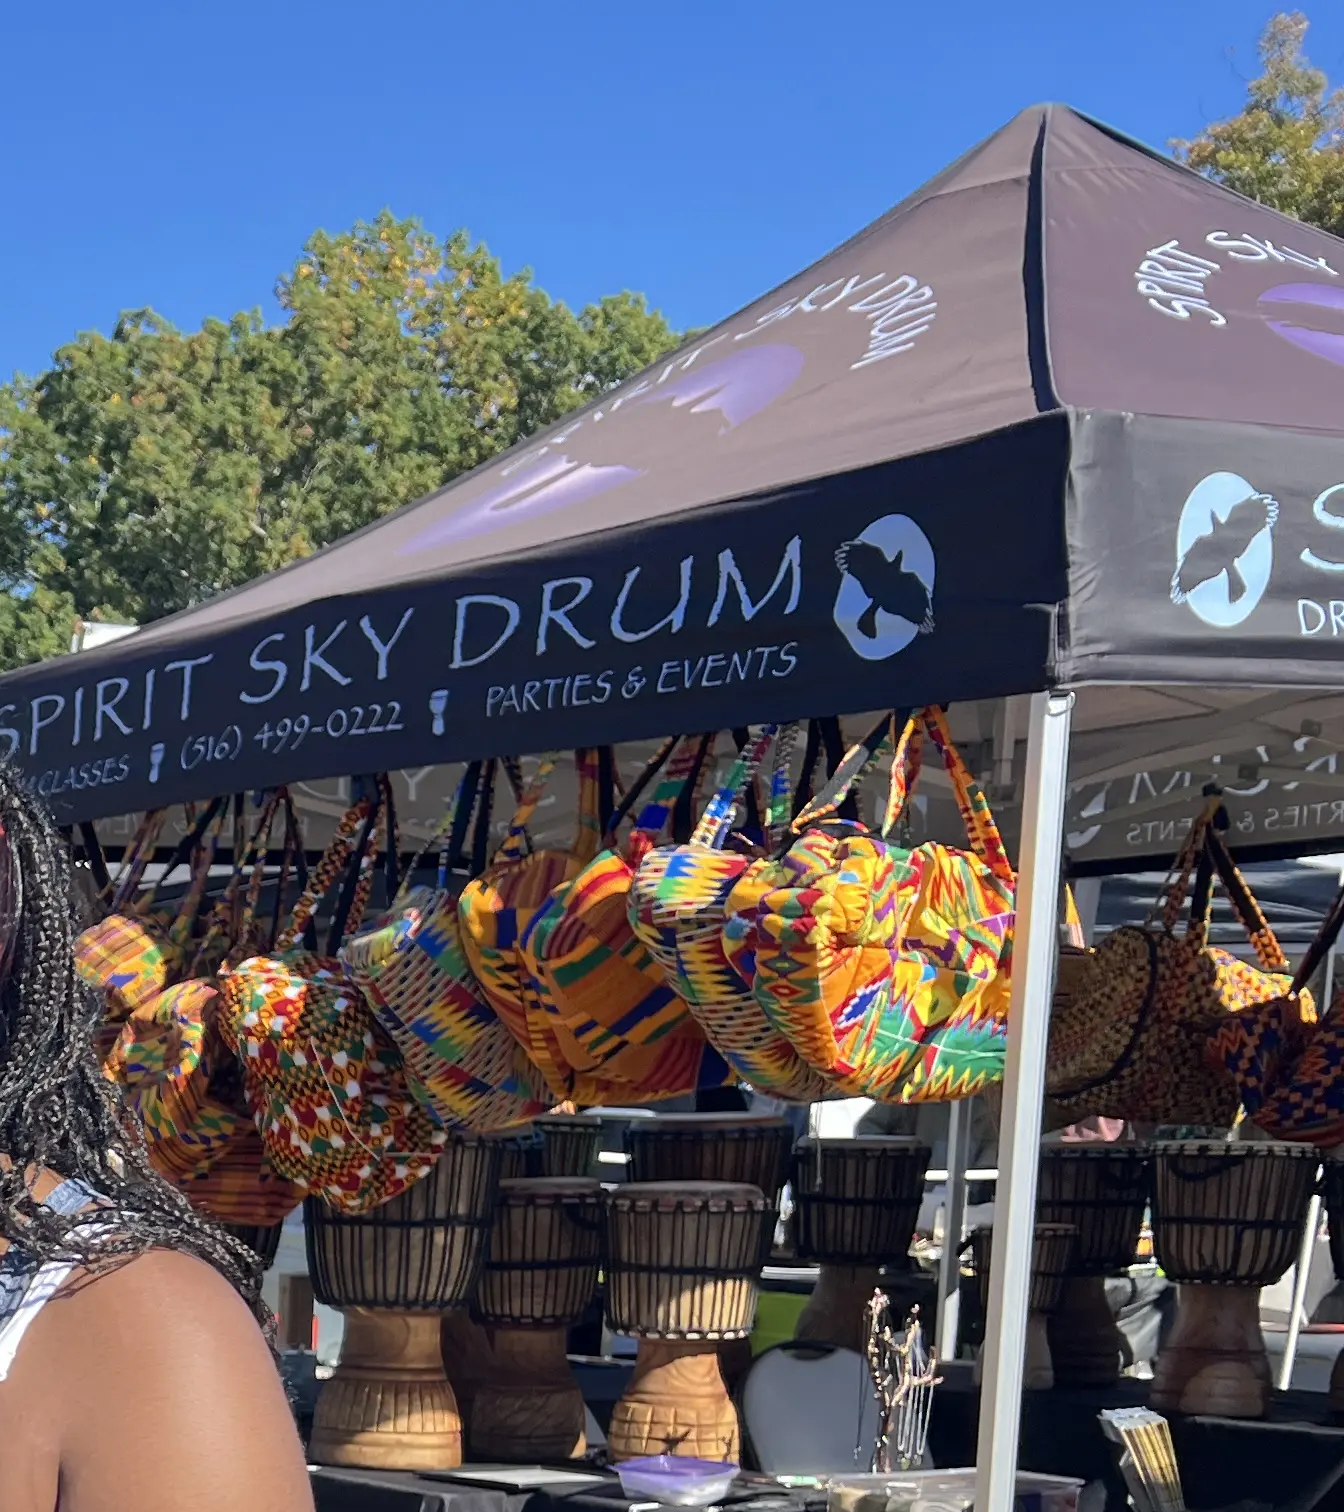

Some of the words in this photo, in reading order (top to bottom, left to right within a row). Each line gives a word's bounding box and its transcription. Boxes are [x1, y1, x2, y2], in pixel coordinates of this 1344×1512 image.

[847, 274, 938, 370] DRUM
[1134, 239, 1228, 328] SPIRIT
[239, 607, 414, 704] SKY
[448, 534, 802, 669] DRUM
[37, 753, 131, 797] CLASSES
[180, 725, 243, 771] (516)
[253, 701, 406, 754] 499-0222
[486, 670, 614, 717] PARTIES
[620, 665, 647, 699] &
[656, 641, 800, 695] EVENTS
